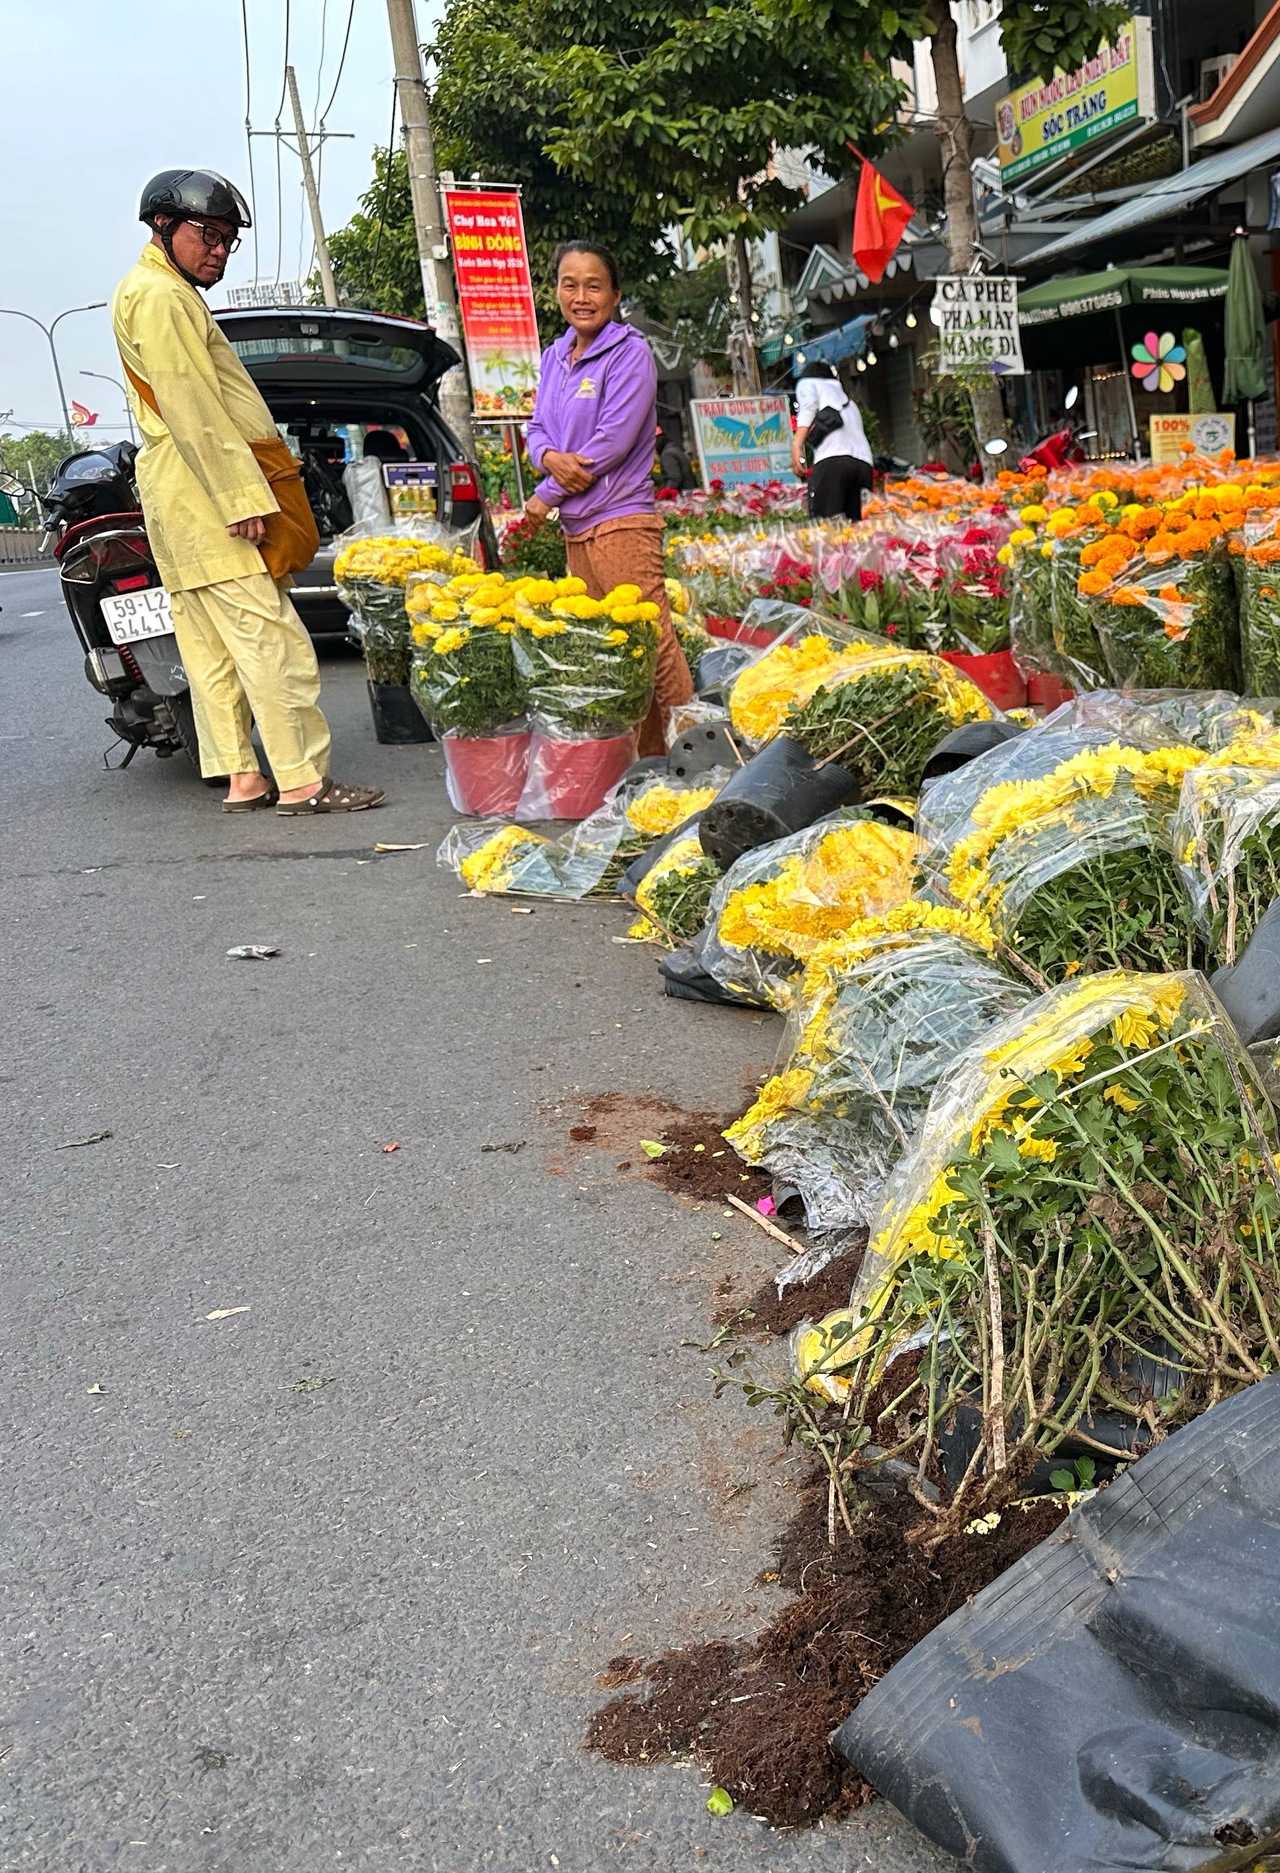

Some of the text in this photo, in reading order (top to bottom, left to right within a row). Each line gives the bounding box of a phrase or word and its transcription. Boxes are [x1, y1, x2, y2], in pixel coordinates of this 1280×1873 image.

[1043, 112, 1064, 141] SÓC
[1065, 90, 1107, 129] TRĂNG
[476, 214, 497, 227] Hoa
[498, 213, 517, 228] Tết
[454, 231, 522, 252] BÌNH ĐÔNG
[974, 278, 1013, 303] PHÊ
[943, 310, 973, 331] PHA
[1154, 419, 1190, 432] 100%
[113, 591, 168, 618] 59-L2
[113, 611, 174, 640] 544.1
